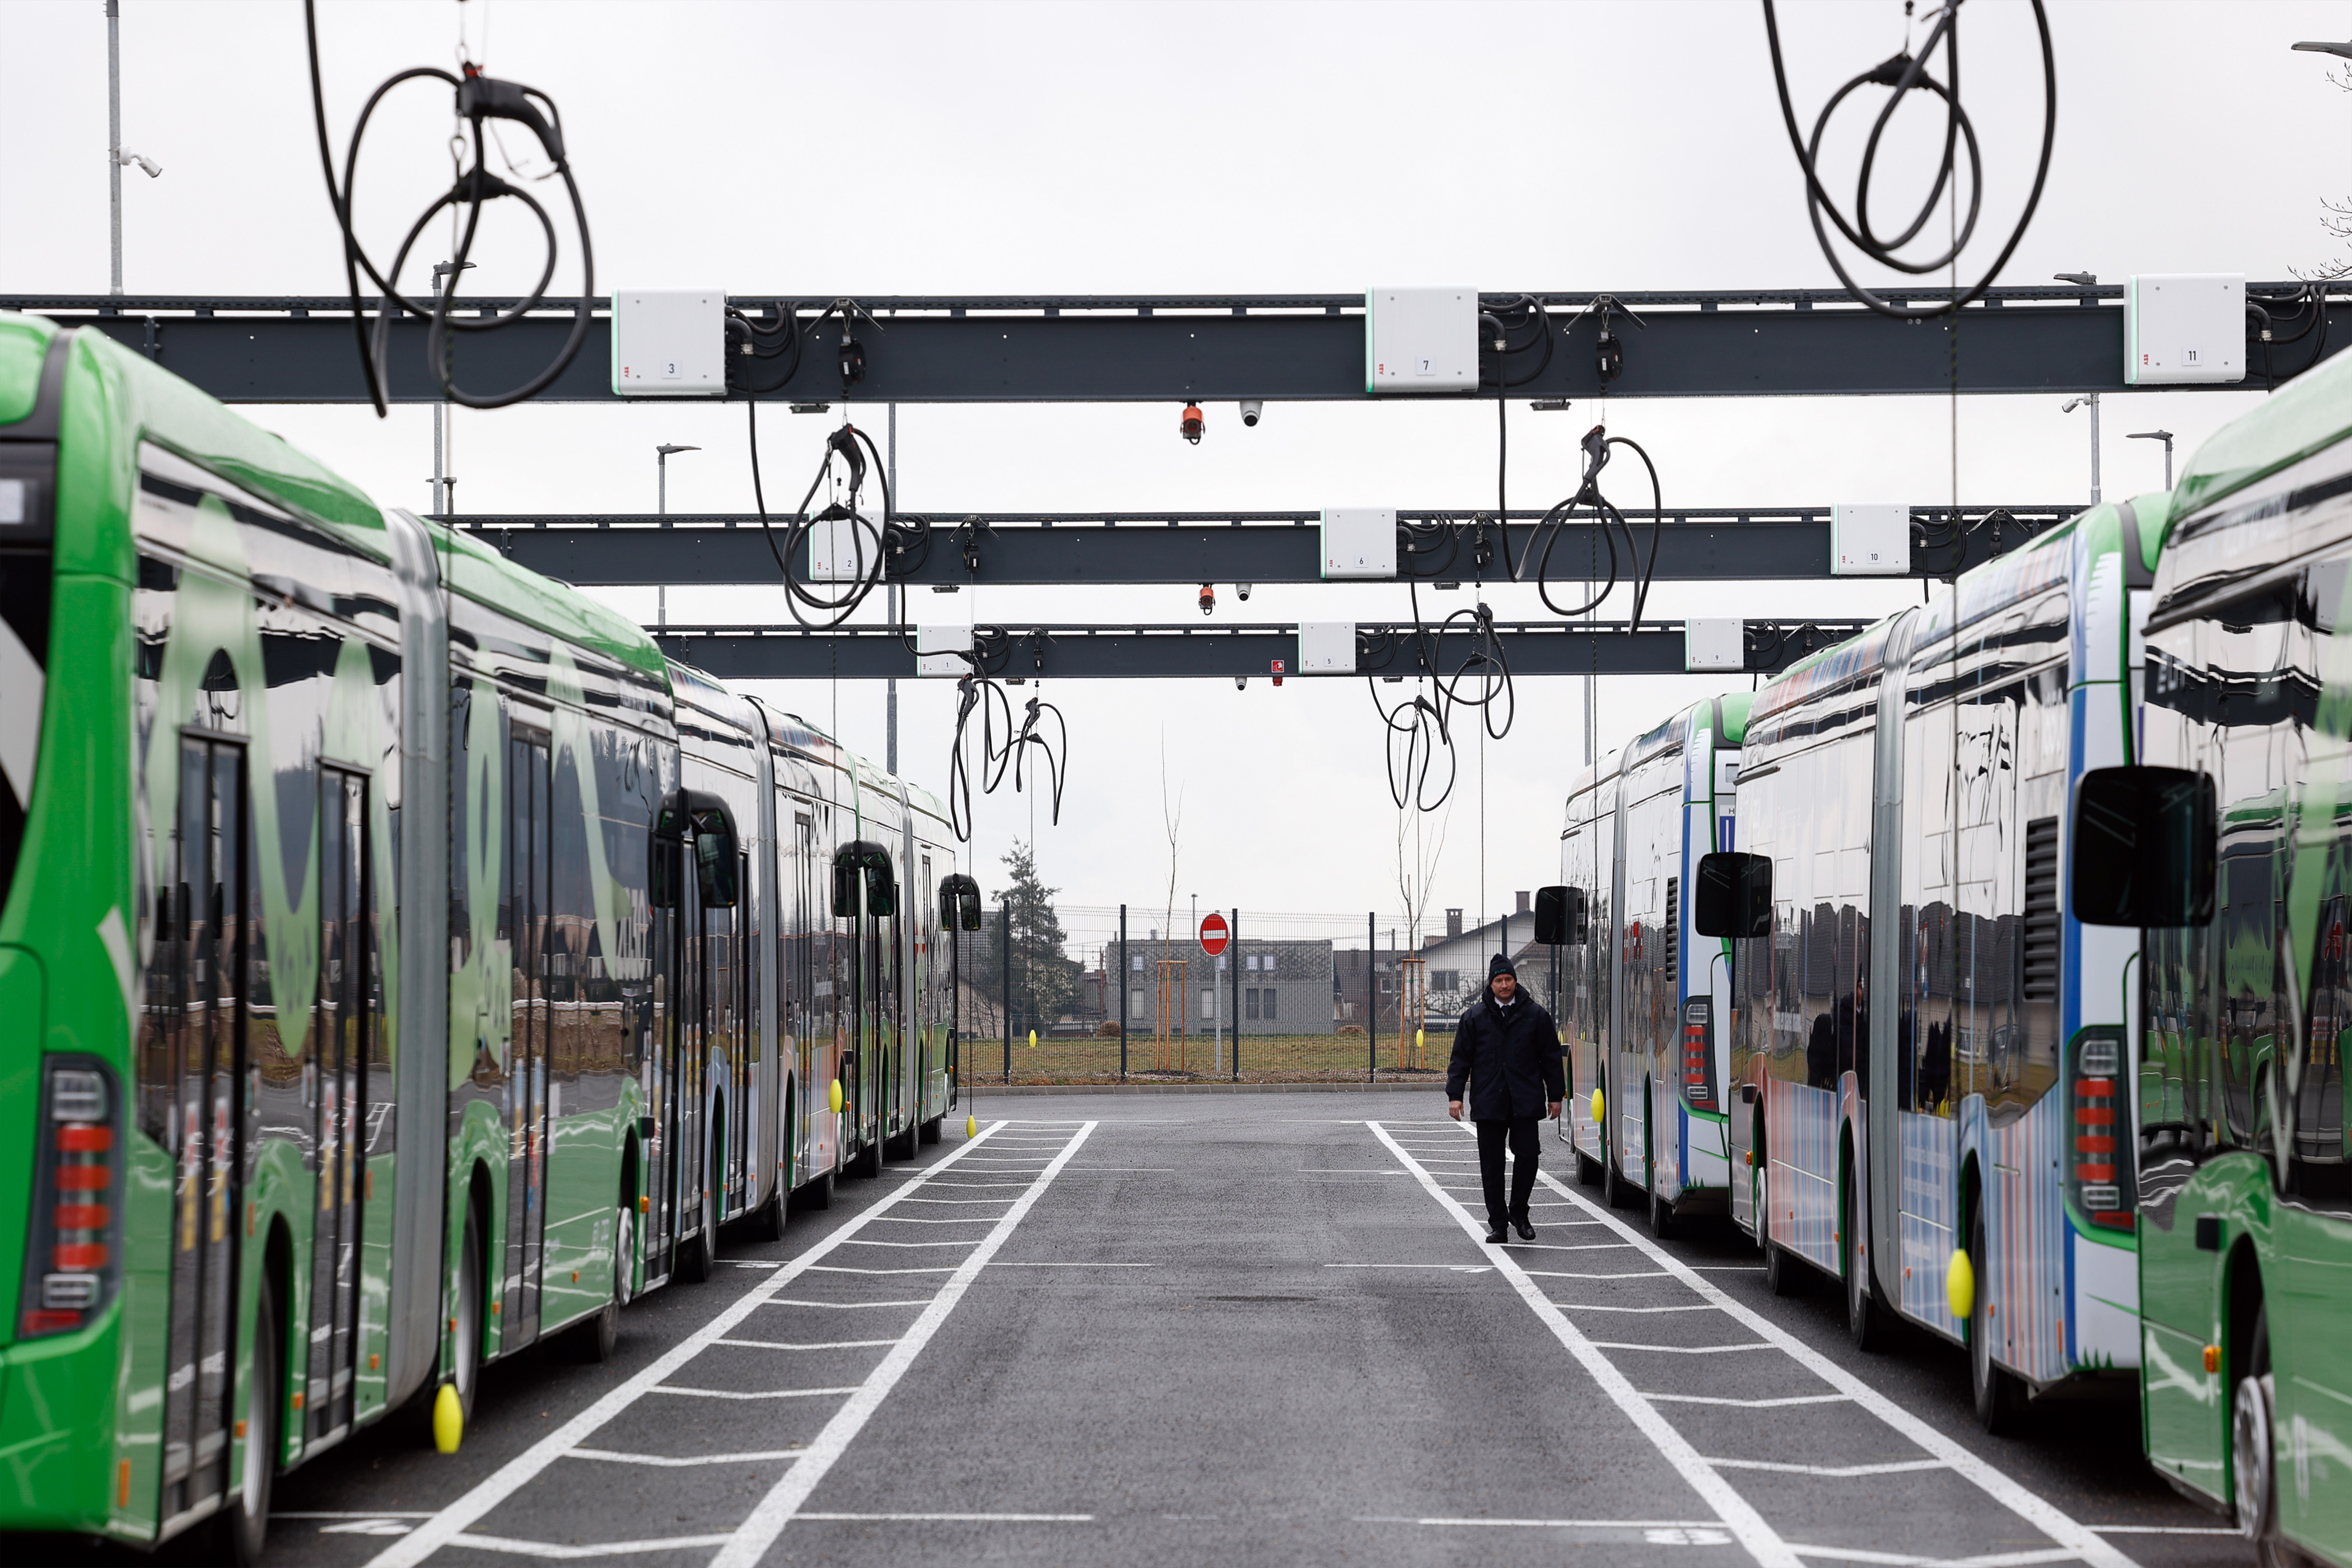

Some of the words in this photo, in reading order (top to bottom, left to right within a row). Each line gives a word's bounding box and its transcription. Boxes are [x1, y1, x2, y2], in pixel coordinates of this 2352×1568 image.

[2188, 351, 2196, 361] 11
[669, 363, 675, 374] 3
[1423, 360, 1429, 370] 7
